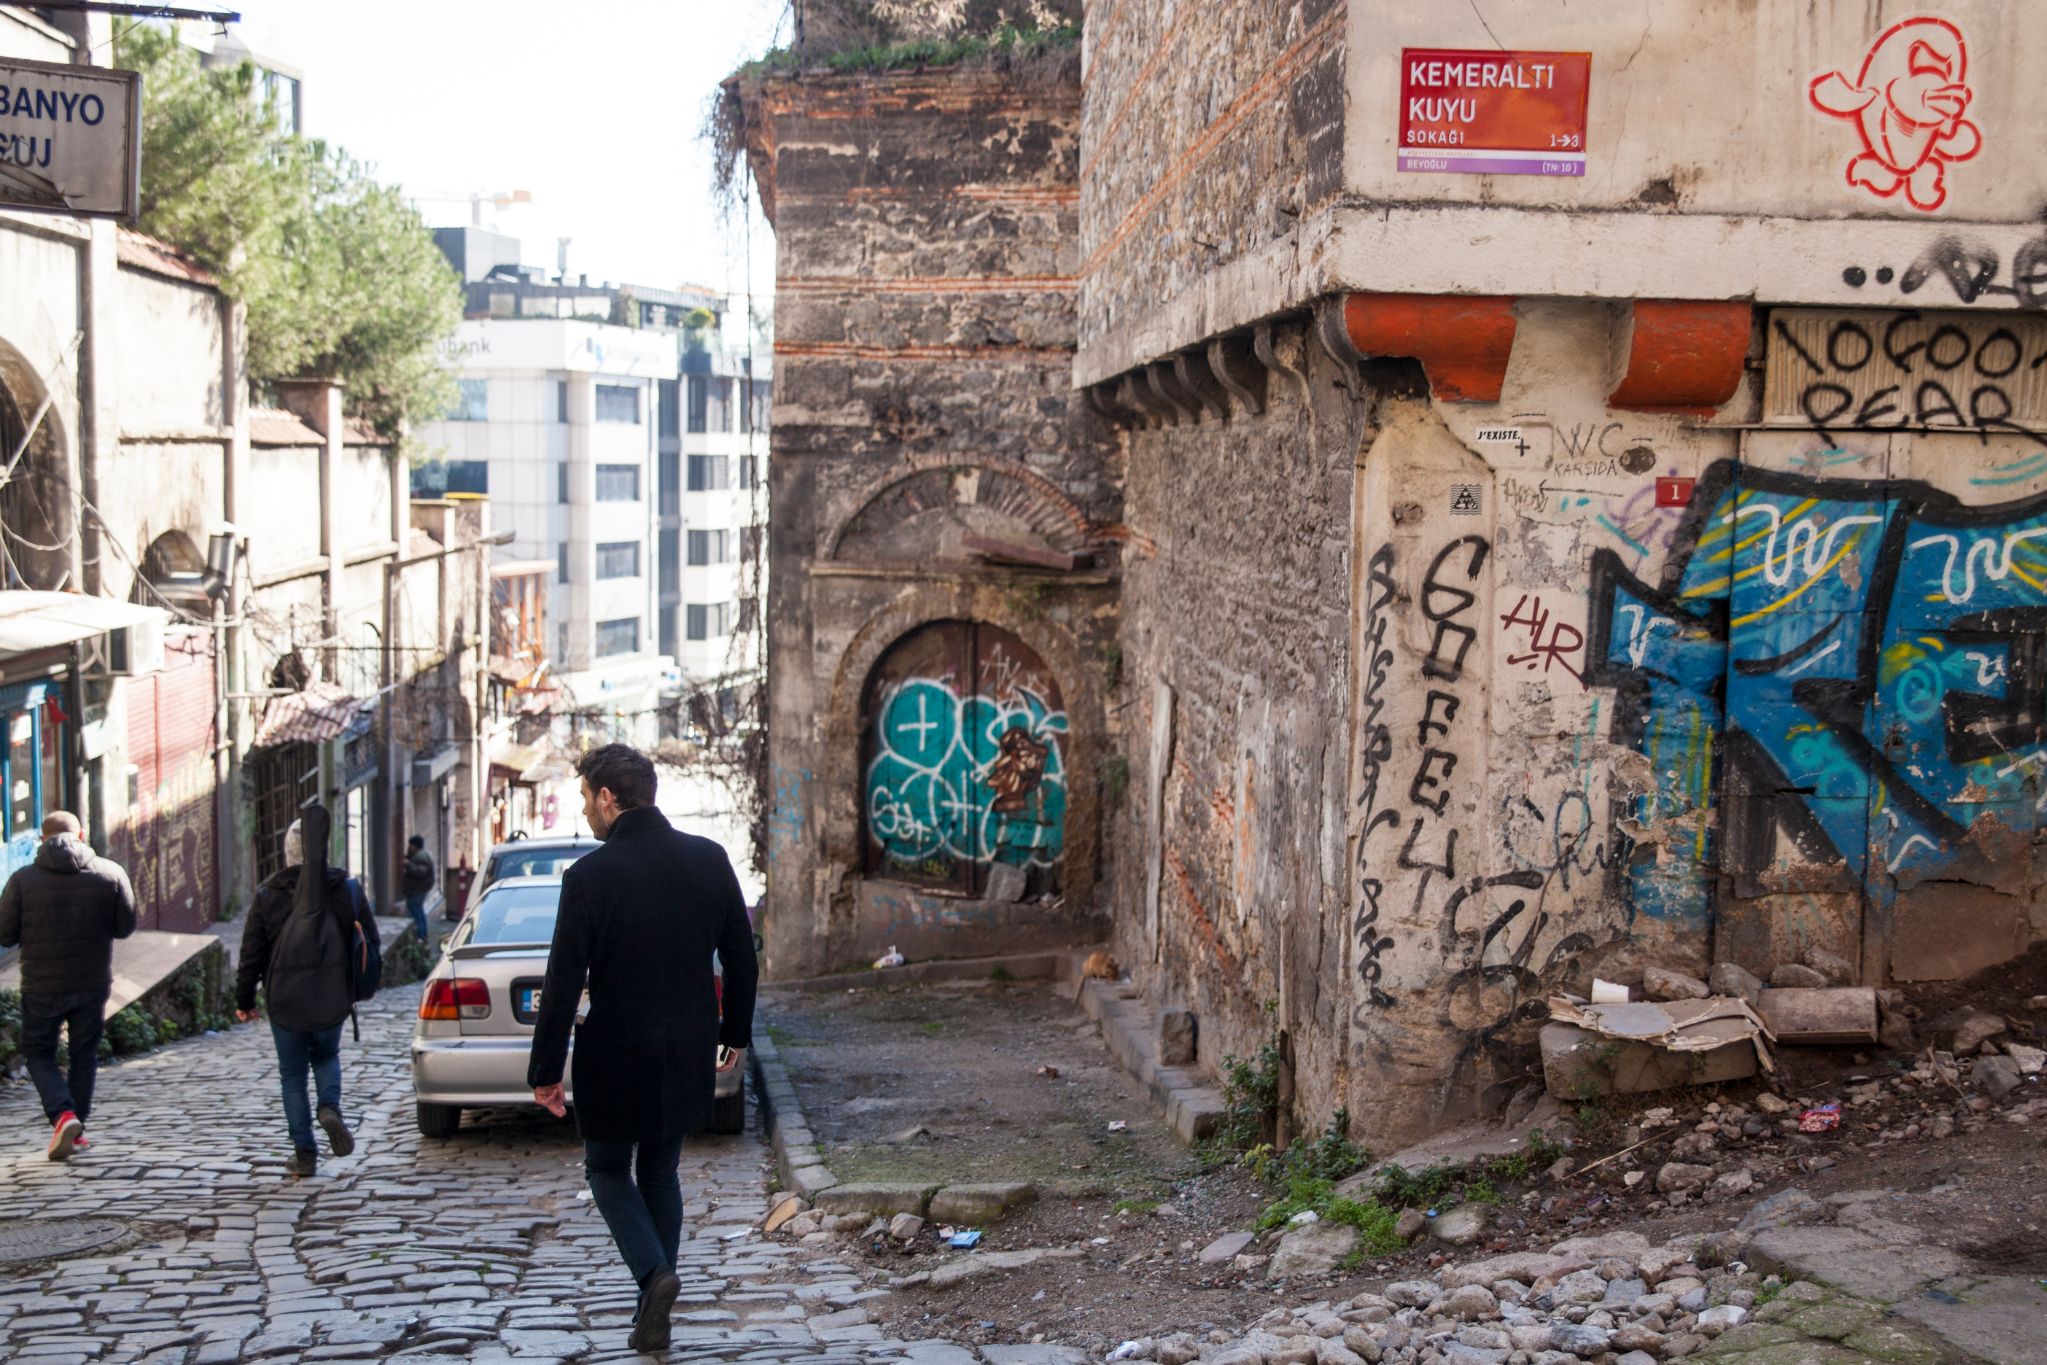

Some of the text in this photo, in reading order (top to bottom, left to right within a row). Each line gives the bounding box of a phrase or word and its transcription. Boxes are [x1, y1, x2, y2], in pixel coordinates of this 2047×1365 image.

[1410, 61, 1555, 89] KEMERALTI
[1408, 97, 1477, 123] KUYU
[1407, 129, 1465, 145] SOKAĞI
[1406, 158, 1448, 170] BEYOĞLU
[1476, 429, 1522, 442] J'EXISTE.
[1555, 421, 1624, 458] WC
[1671, 484, 1680, 501] 1
